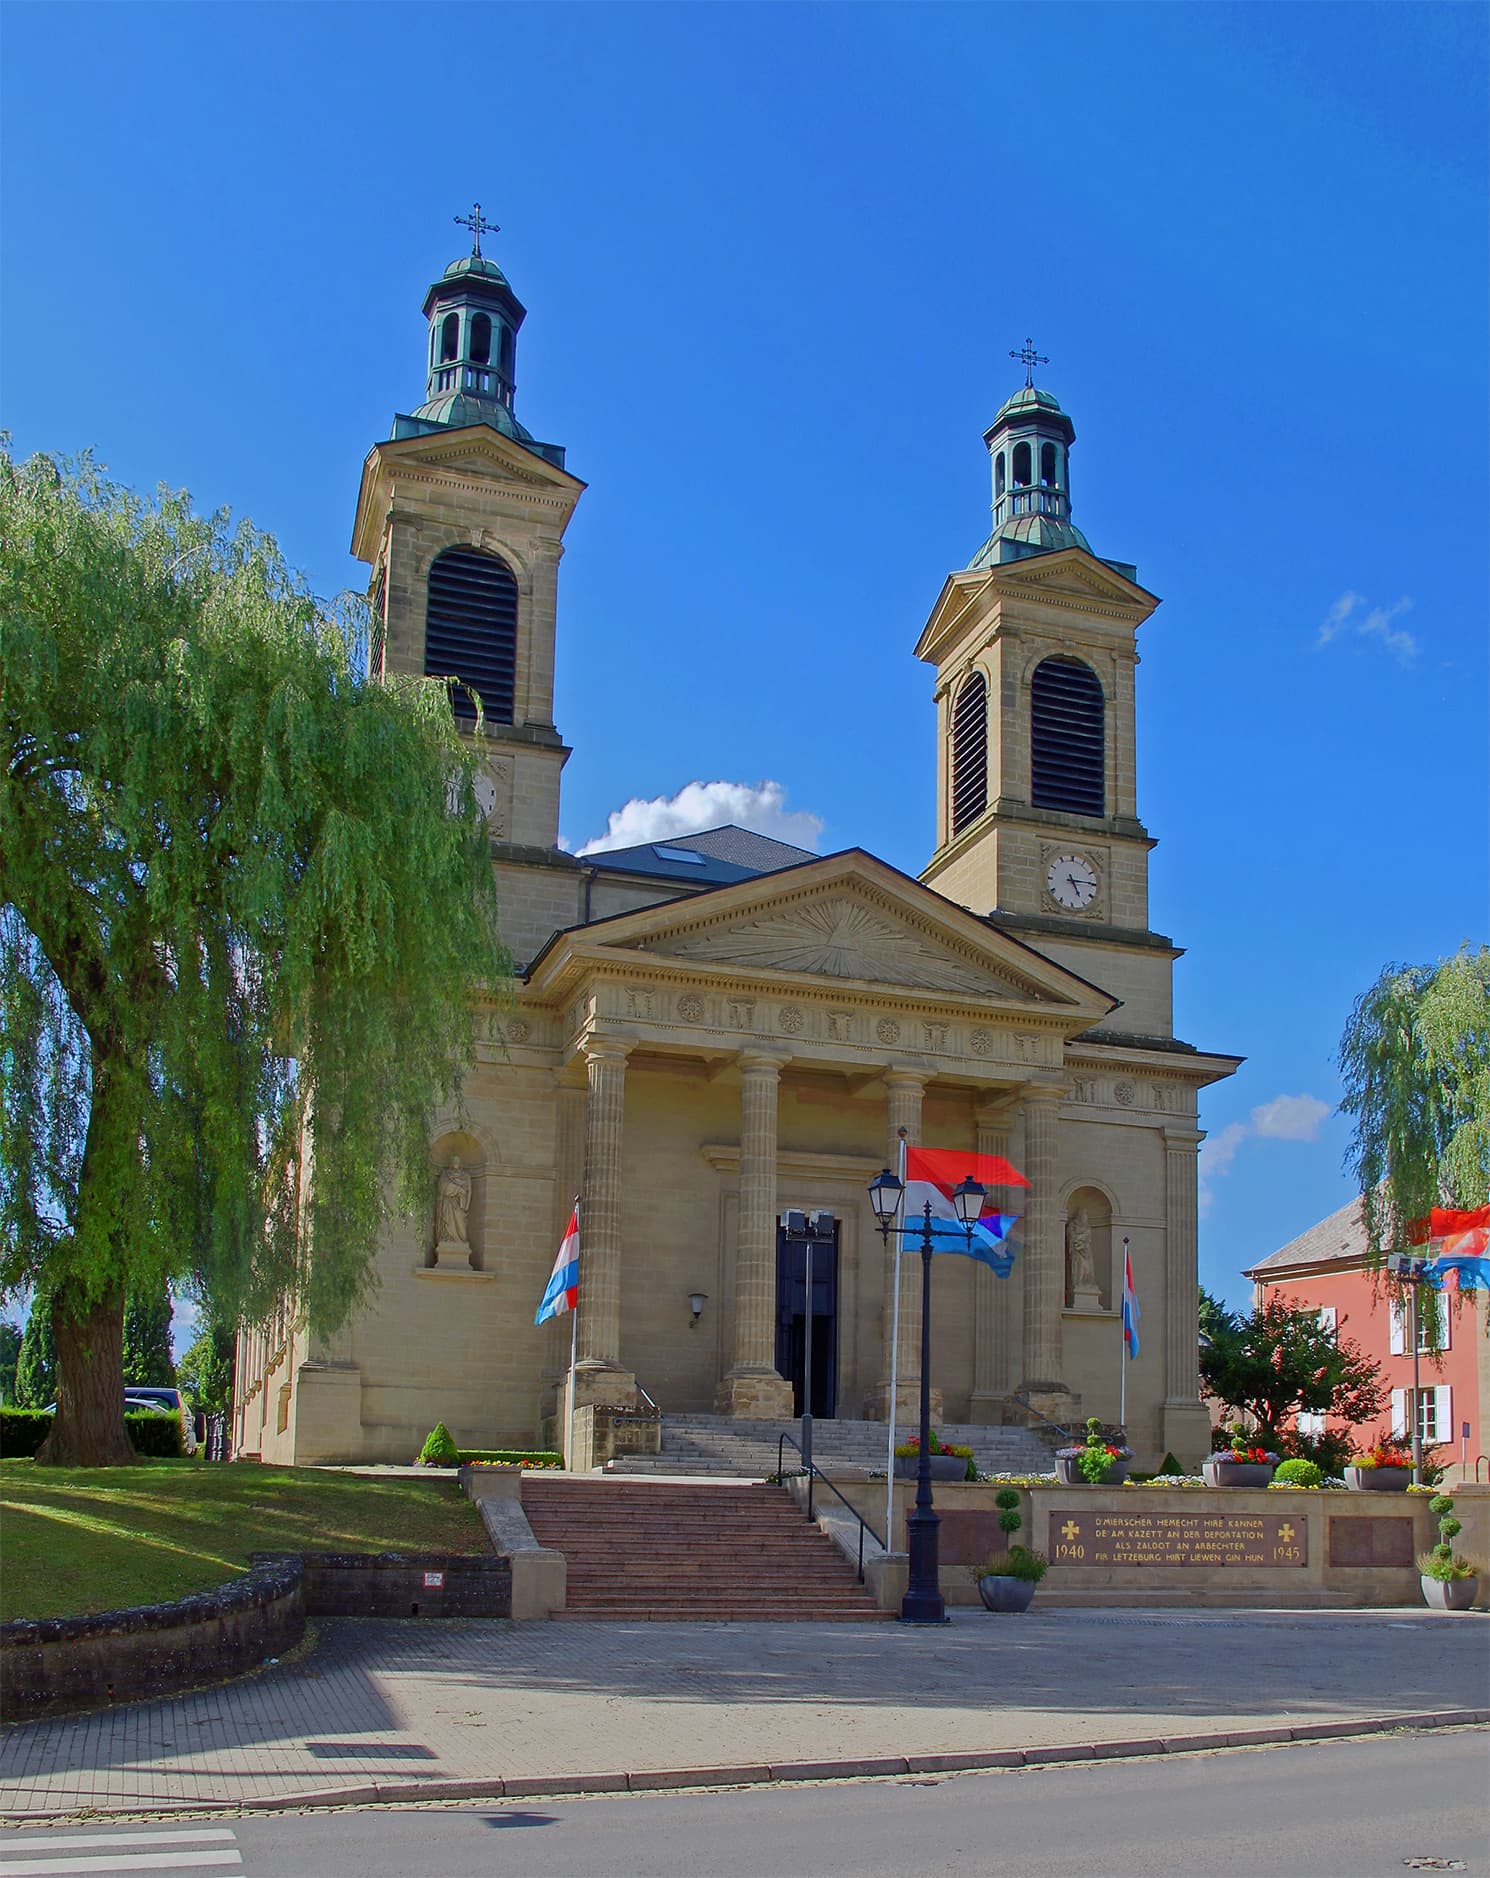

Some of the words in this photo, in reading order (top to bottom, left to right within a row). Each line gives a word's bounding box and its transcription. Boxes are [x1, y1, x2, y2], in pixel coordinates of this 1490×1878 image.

[1157, 1519, 1199, 1527] HEMECHT
[1204, 1519, 1223, 1527] HIRE
[1228, 1520, 1264, 1528] KANNER
[1128, 1530, 1163, 1538] KAZETT
[1167, 1530, 1180, 1538] AN
[1204, 1531, 1264, 1539] DEPORTATION
[1176, 1542, 1189, 1550] AN
[1195, 1542, 1245, 1550] ARBECHTER
[1055, 1544, 1085, 1559] 1940
[1273, 1546, 1300, 1560] 1945
[1095, 1552, 1108, 1561] FIR
[1113, 1553, 1161, 1561] LETZEBURG
[1190, 1553, 1221, 1561] LIEWEN
[1245, 1553, 1264, 1561] HUN
